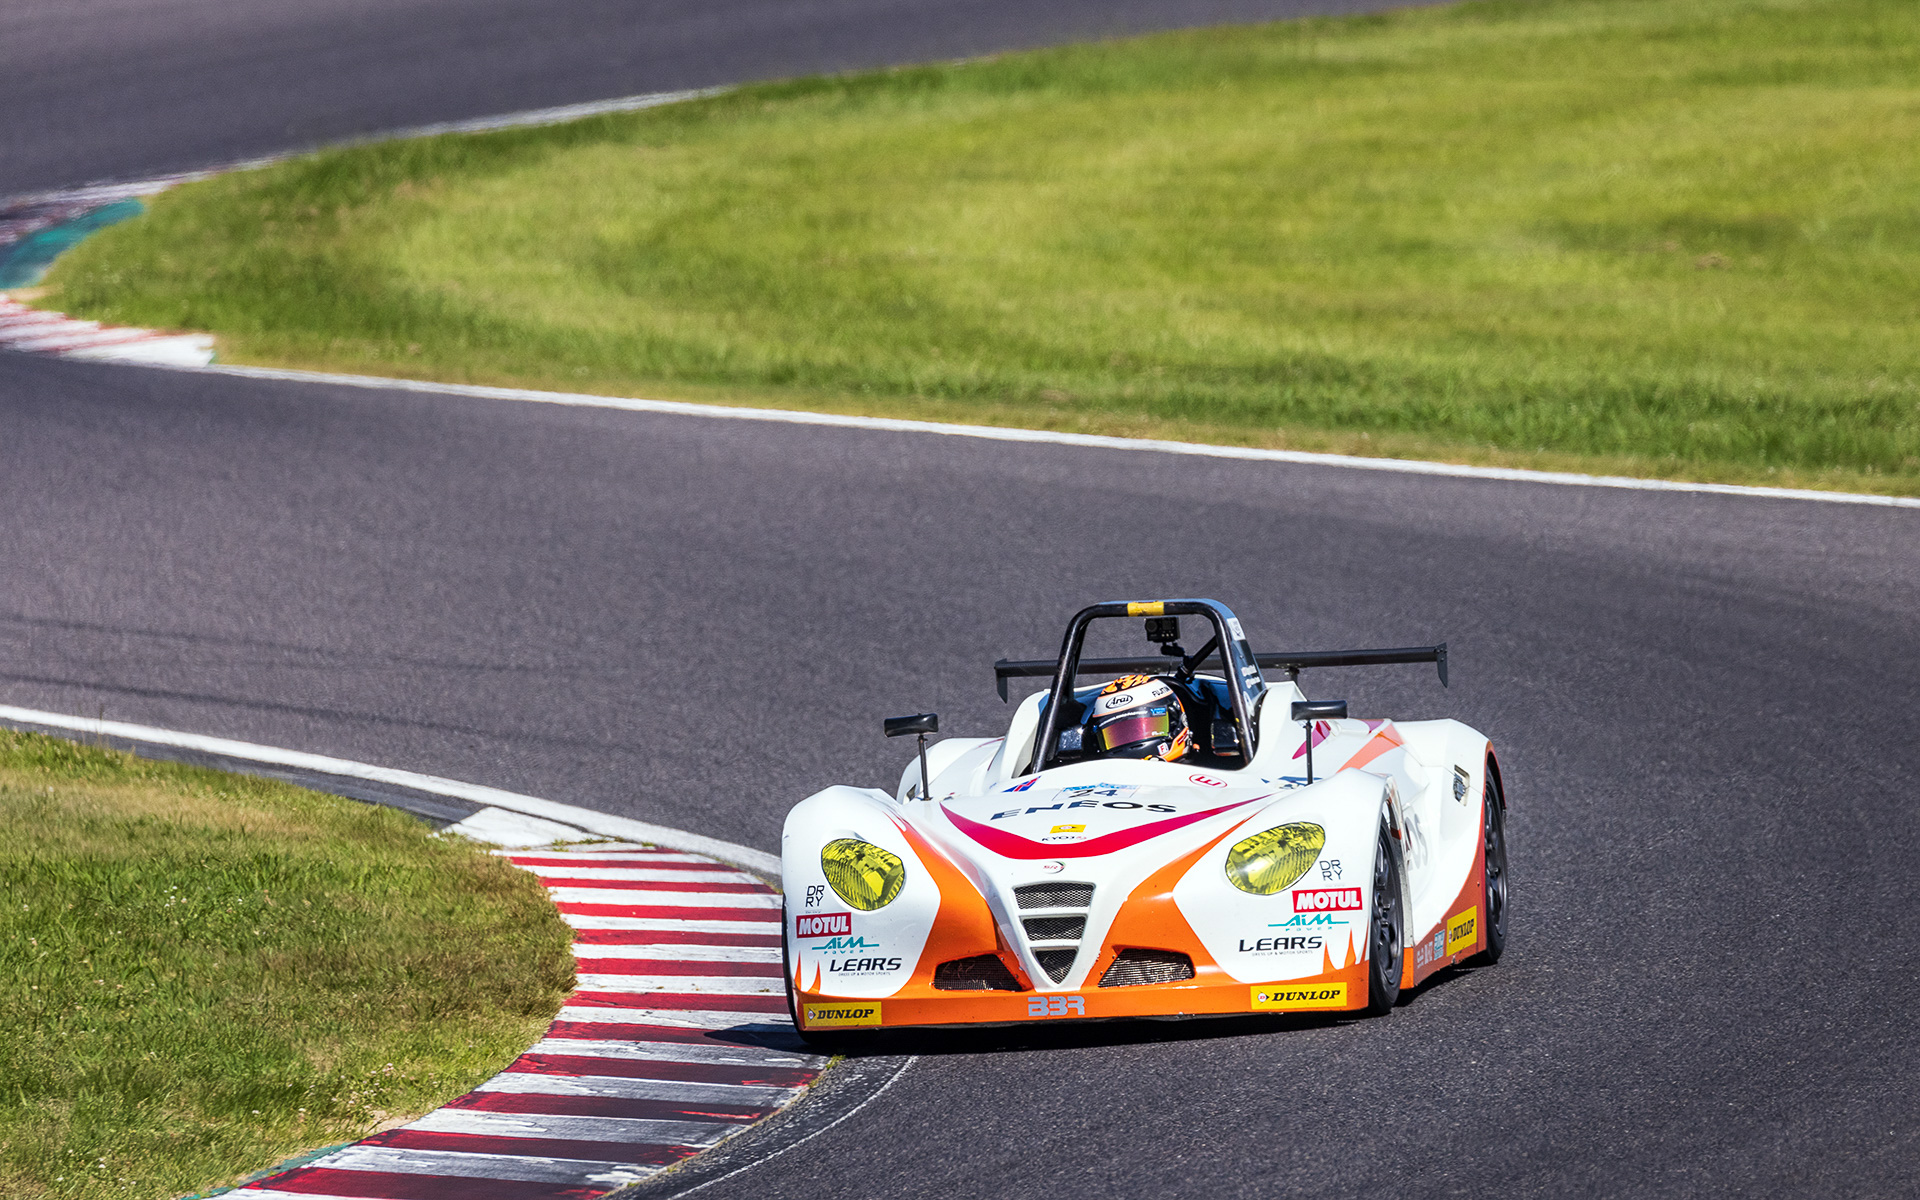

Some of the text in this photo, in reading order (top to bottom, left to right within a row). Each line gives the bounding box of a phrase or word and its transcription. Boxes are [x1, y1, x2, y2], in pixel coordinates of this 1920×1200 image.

[1111, 695, 1129, 706] Arai
[1068, 788, 1118, 798] 24
[990, 800, 1177, 820] ENEOS
[1296, 890, 1360, 910] MOTUL
[798, 915, 849, 935] MOTUL
[1452, 918, 1474, 942] DUNLOP
[1238, 936, 1323, 952] LEARS
[829, 957, 902, 972] LEARS
[1271, 990, 1341, 1002] DUNLOP
[817, 1008, 874, 1020] DUNLOP
